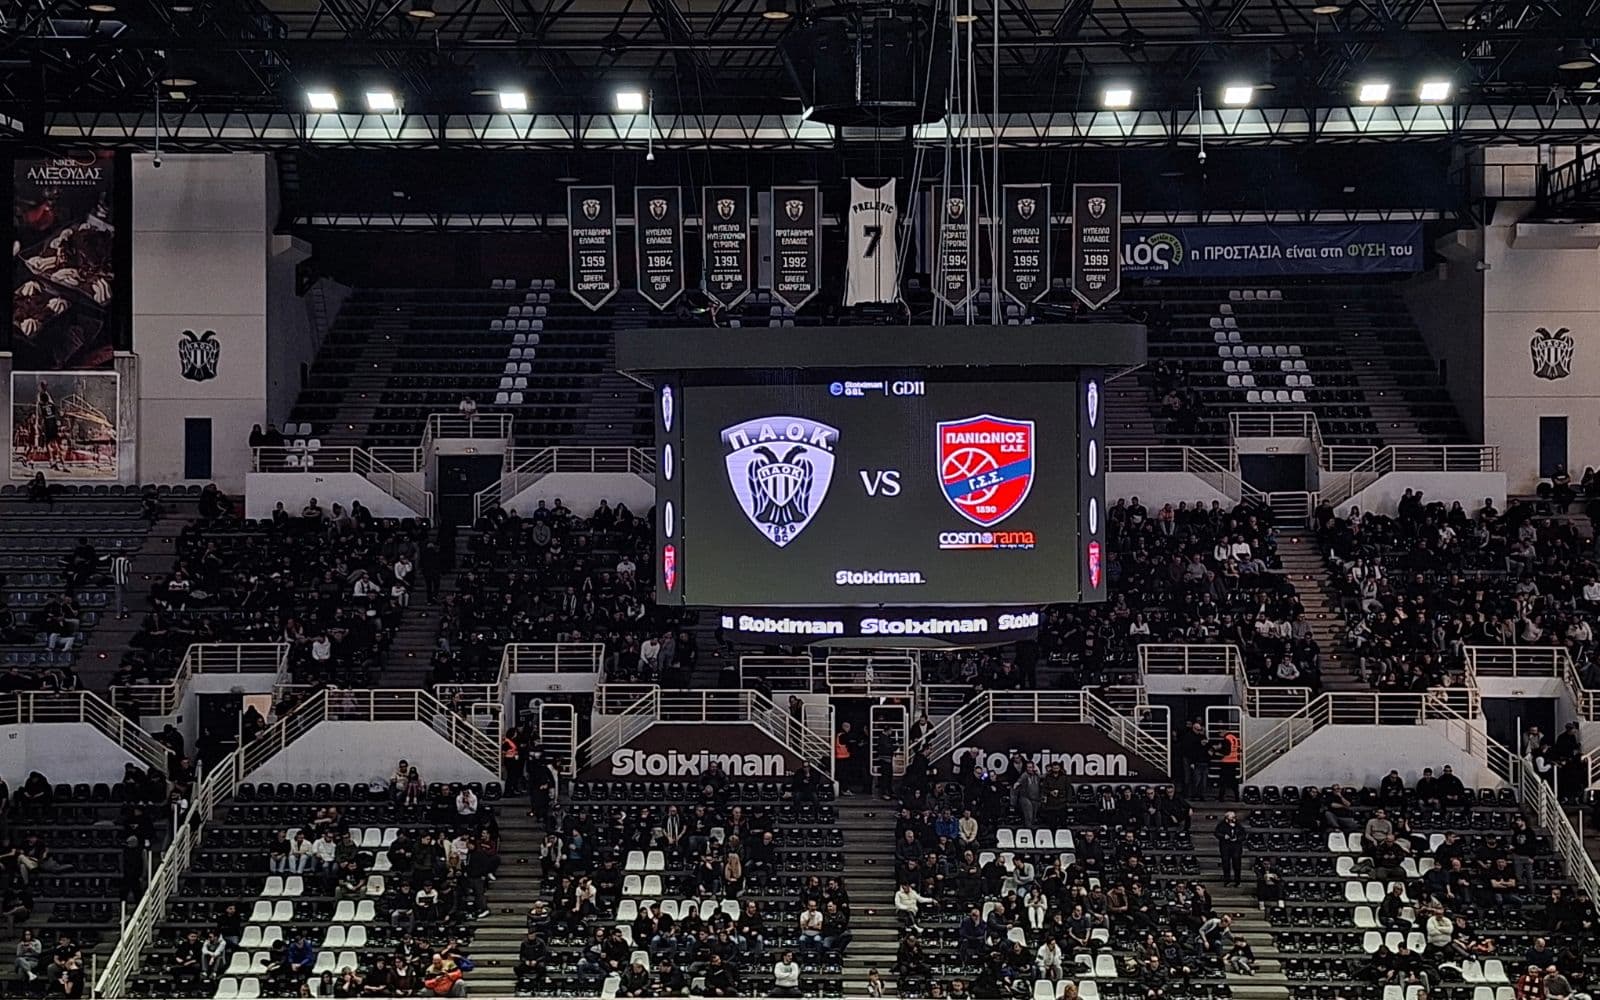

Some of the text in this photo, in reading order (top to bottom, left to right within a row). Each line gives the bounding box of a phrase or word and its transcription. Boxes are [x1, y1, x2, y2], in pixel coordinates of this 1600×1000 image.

[27, 167, 103, 179] ΑΛΕΞΟΥΔΑΣ
[852, 201, 895, 214] PRELEVIC
[863, 225, 884, 258] 7
[1191, 243, 1413, 260] η ΠΡΟΣΤΑΣΙΑ είναι στη ΦΥΣΗ του
[581, 256, 605, 267] 1959
[648, 256, 672, 267] 1984
[783, 257, 807, 268] 1992
[943, 255, 967, 266] 1994
[1014, 256, 1038, 267] 1995
[1084, 255, 1109, 266] 1999
[949, 282, 961, 290] CUP
[892, 381, 925, 395] GD11
[945, 432, 1026, 444] ΠΑΝΙΩΝΙΟΣ
[760, 465, 802, 480] ΠΑΟΚ
[859, 470, 901, 496] VS
[975, 505, 997, 514] 1890
[774, 534, 788, 542] BC
[939, 531, 1034, 544] cosmorama
[739, 615, 844, 634] Stoiximan
[860, 618, 988, 634] Stoiximan
[611, 749, 785, 776] Stoiximan
